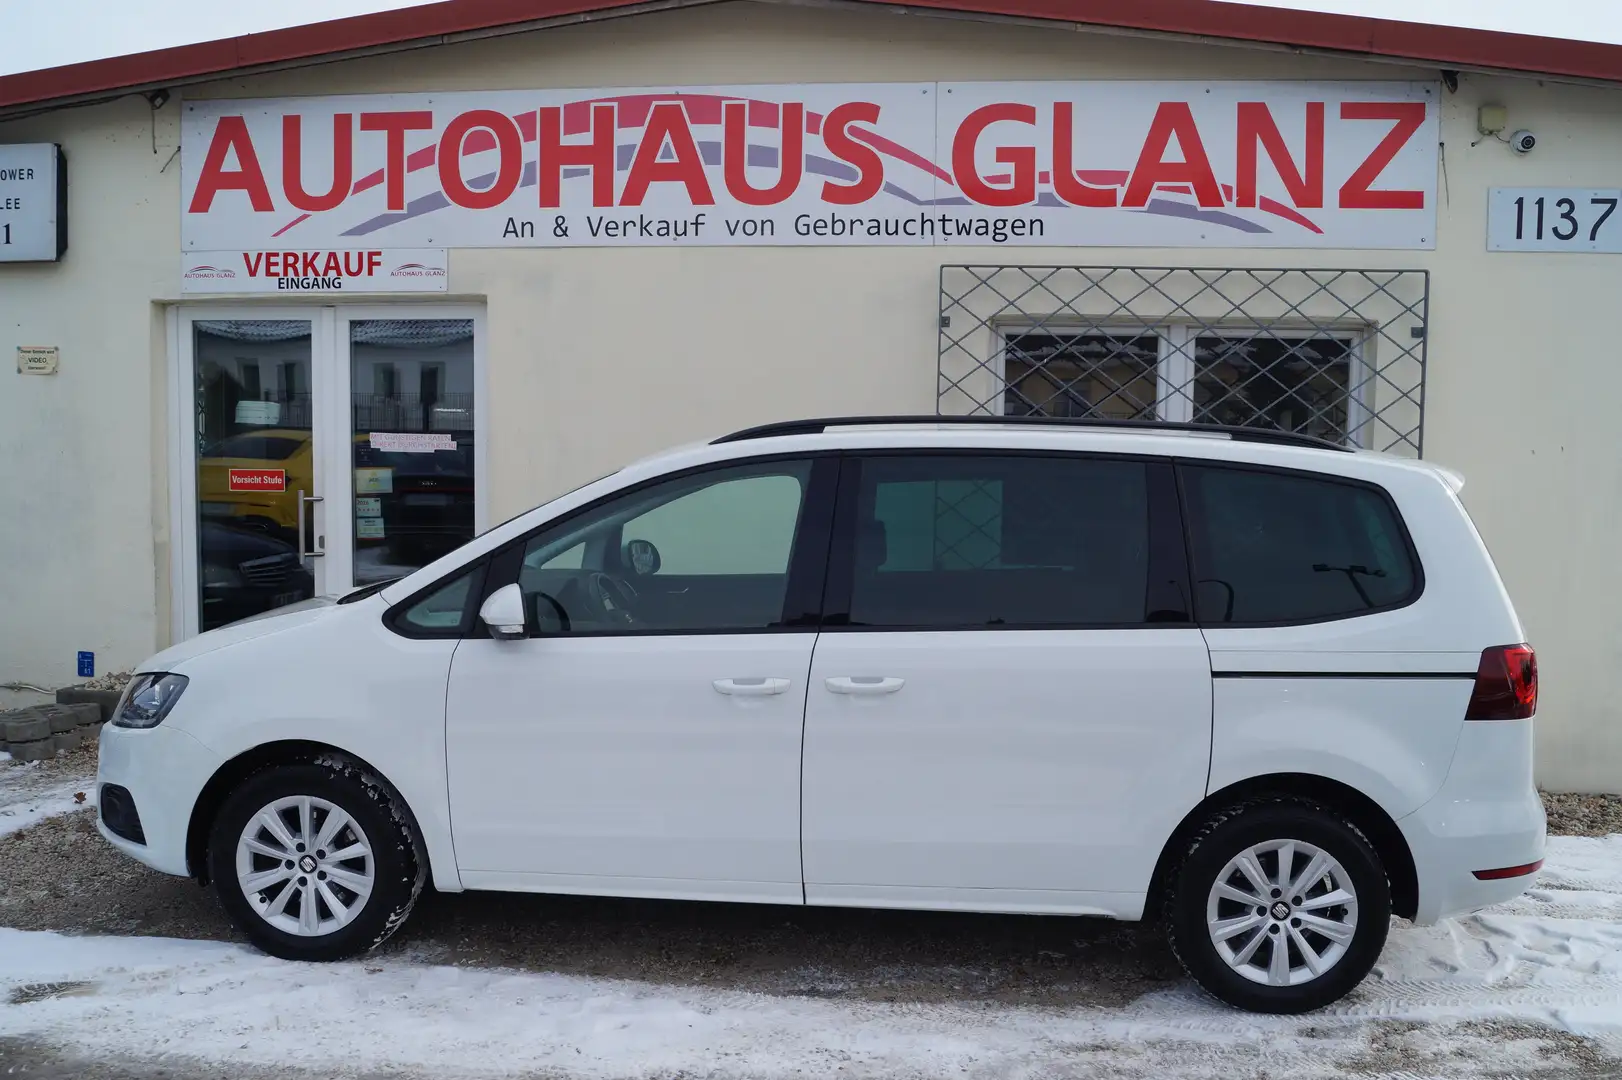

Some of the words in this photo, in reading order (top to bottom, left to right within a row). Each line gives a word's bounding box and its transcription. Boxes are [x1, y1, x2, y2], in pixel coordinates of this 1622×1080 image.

[188, 101, 884, 213] AUTOHAUS
[951, 101, 1426, 209] GLANZ
[502, 217, 535, 238] An
[552, 217, 569, 238] &
[586, 213, 706, 237] Verkauf
[726, 219, 775, 237] von
[794, 212, 1045, 242] Gebrauchtwagen
[1514, 196, 1618, 242] 1137
[242, 250, 383, 278] VERKAUF
[277, 277, 342, 290] EINGANG
[232, 476, 262, 484] Vorsicht
[263, 476, 282, 484] Stufe
